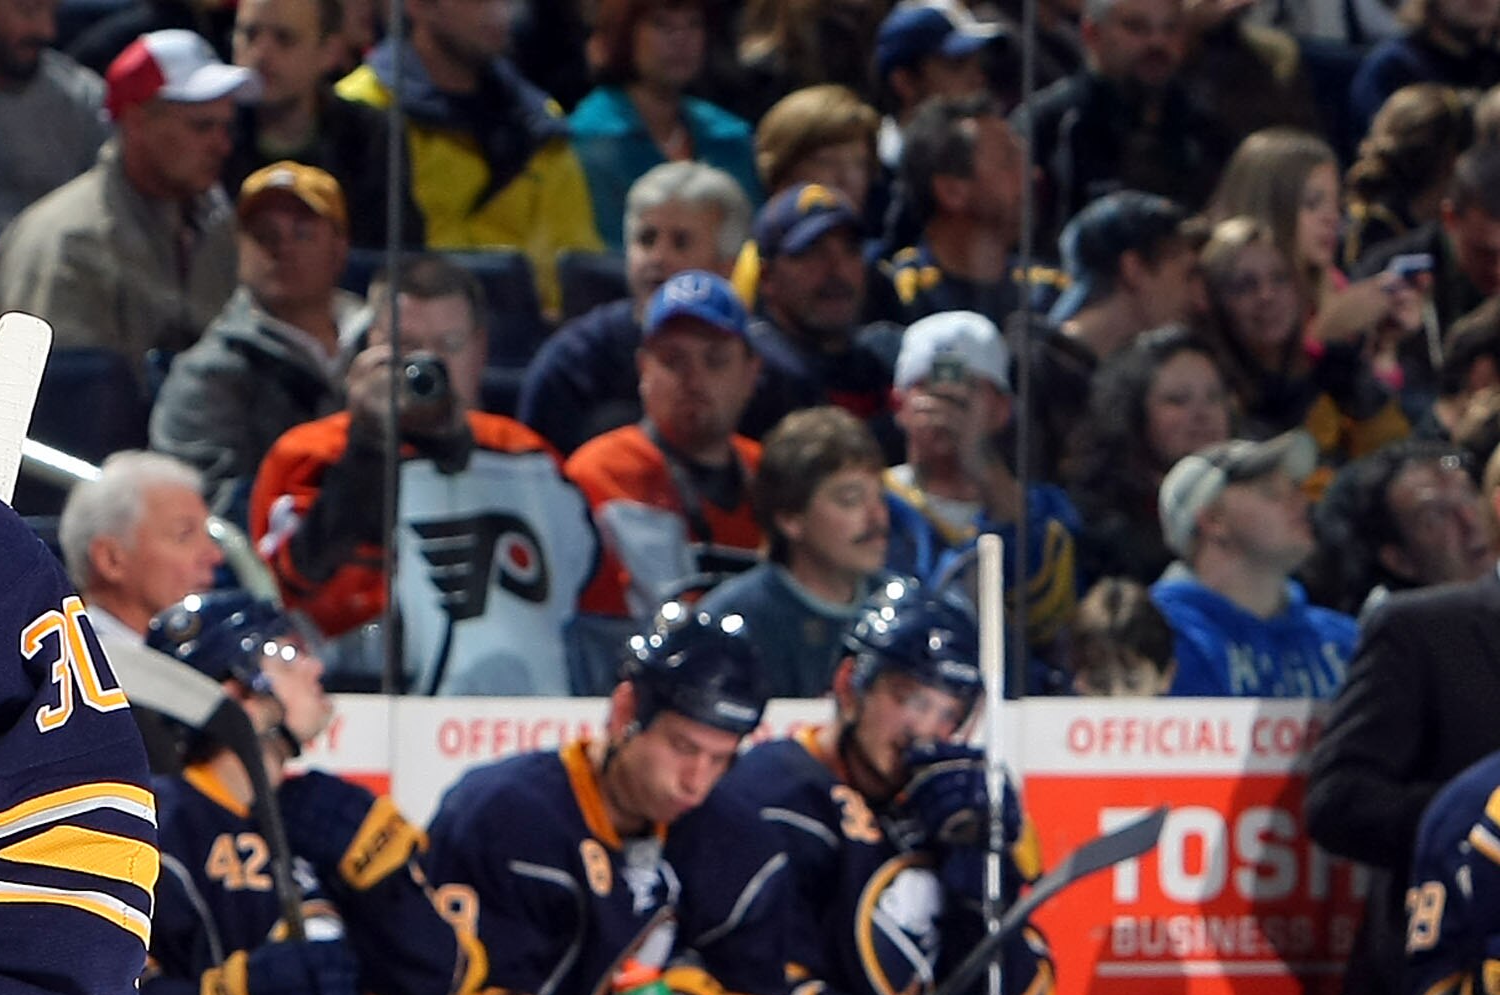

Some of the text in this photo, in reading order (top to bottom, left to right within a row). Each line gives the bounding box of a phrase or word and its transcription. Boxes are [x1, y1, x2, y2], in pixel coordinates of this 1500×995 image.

[1067, 718, 1236, 757] OFFICIAL
[205, 833, 274, 891] 42
[1111, 915, 1314, 957] BUSINESS
